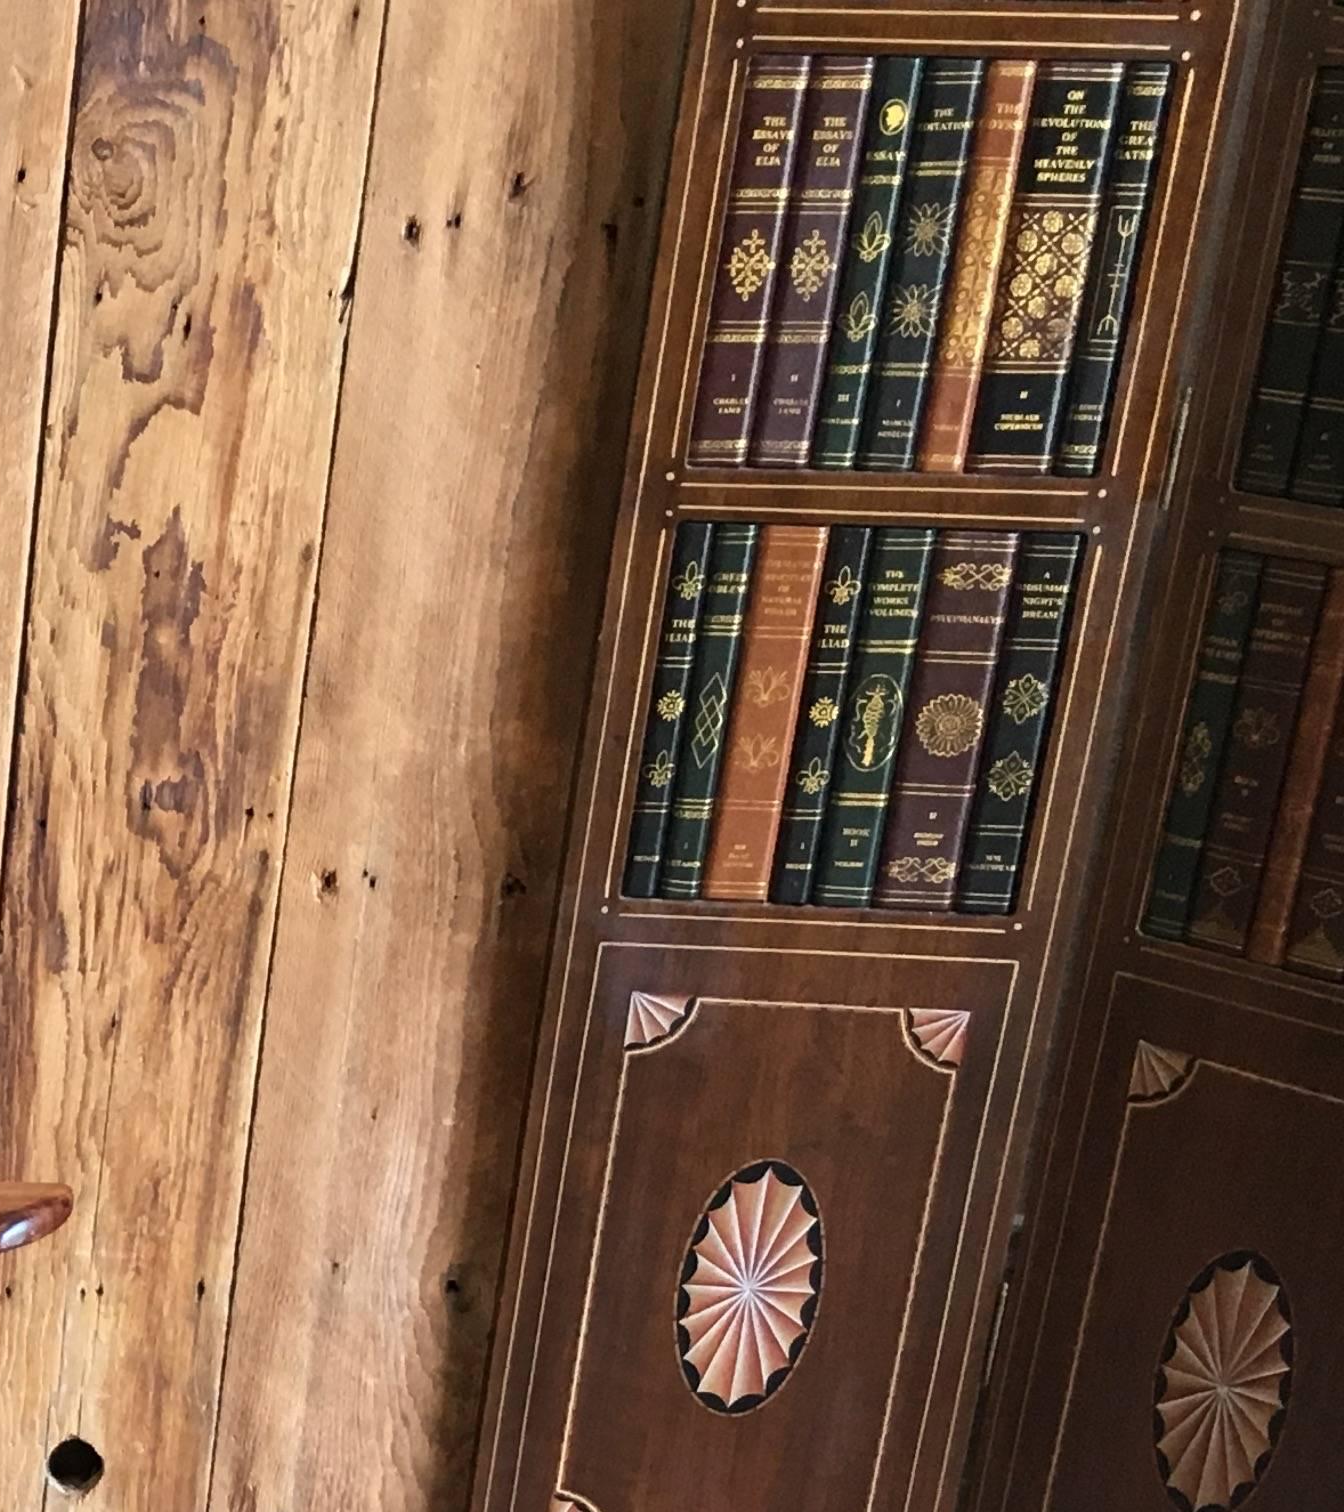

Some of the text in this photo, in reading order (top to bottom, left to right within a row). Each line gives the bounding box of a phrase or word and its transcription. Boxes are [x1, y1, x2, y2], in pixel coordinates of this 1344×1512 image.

[1067, 90, 1086, 100] ON
[934, 108, 954, 118] THE
[1063, 104, 1087, 114] THE
[763, 116, 787, 127] THE
[823, 116, 847, 127] THE
[1130, 120, 1157, 131] THE
[752, 129, 795, 141] ESSAYS
[813, 129, 854, 141] ESSAYS
[1062, 132, 1078, 142] OF
[763, 143, 780, 153] OF
[823, 143, 840, 154] OF
[1056, 146, 1079, 156] THE
[755, 156, 781, 167] ELIA
[815, 156, 841, 167] ELIA
[1033, 159, 1095, 169] HEAVENLY
[1036, 172, 1087, 183] SPHERES
[1043, 571, 1051, 580] A
[672, 619, 696, 629] THE
[823, 624, 848, 634] THE
[817, 638, 850, 649] ILIAD
